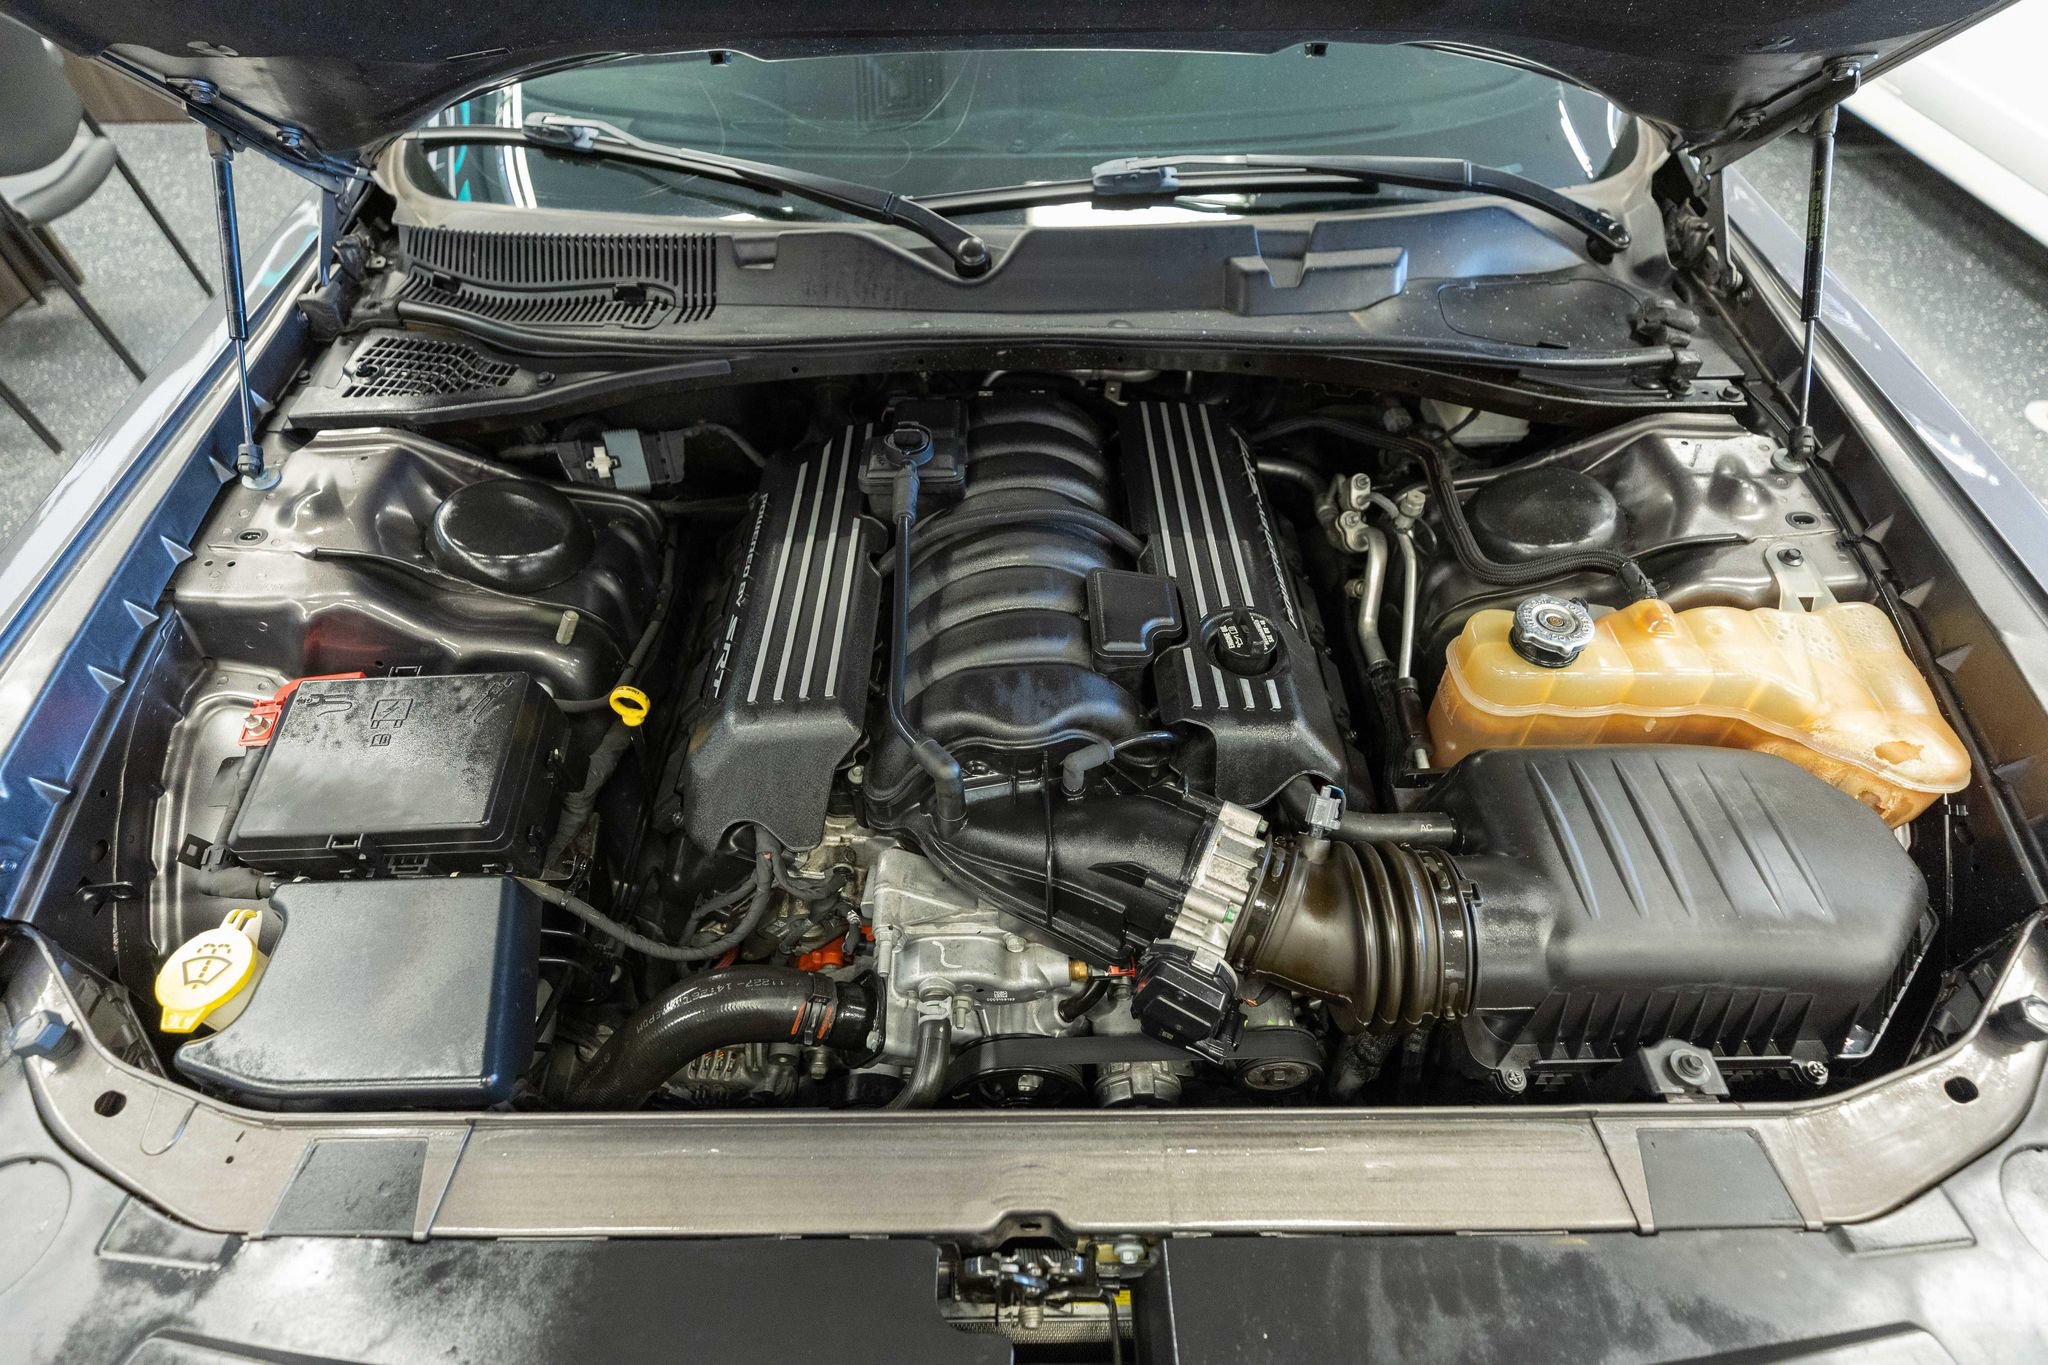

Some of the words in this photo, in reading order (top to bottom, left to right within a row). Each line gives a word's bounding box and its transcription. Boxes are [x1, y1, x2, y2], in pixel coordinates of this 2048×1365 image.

[743, 493, 769, 578] POWERED
[713, 614, 738, 699] SRT
[1420, 823, 1433, 833] AC
